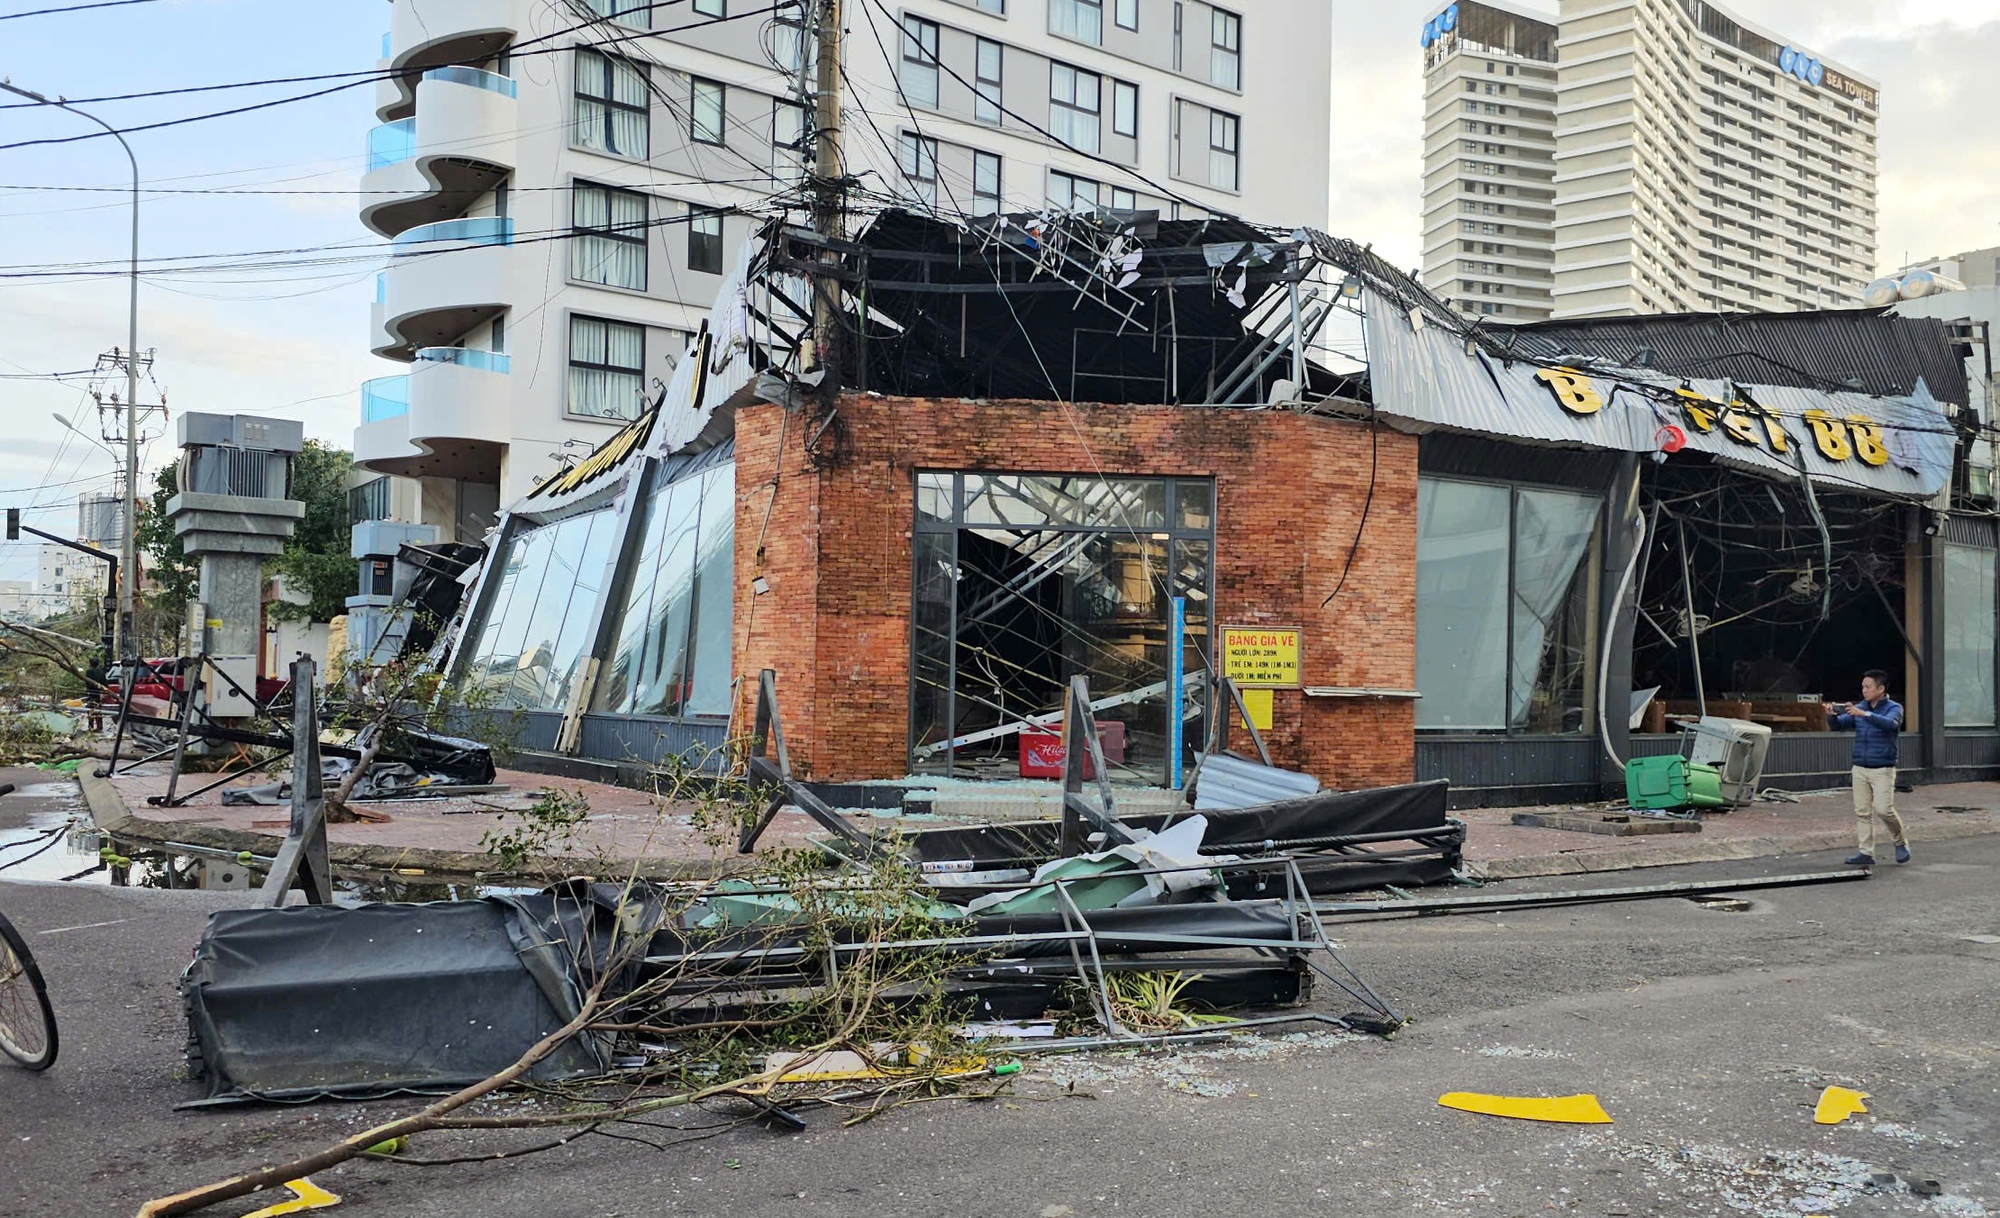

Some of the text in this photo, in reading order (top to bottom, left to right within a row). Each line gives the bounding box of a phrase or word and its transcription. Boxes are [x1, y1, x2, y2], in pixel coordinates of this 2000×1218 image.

[1783, 51, 1873, 104] FLC SEA TOWER
[1263, 649, 1278, 657] 289K
